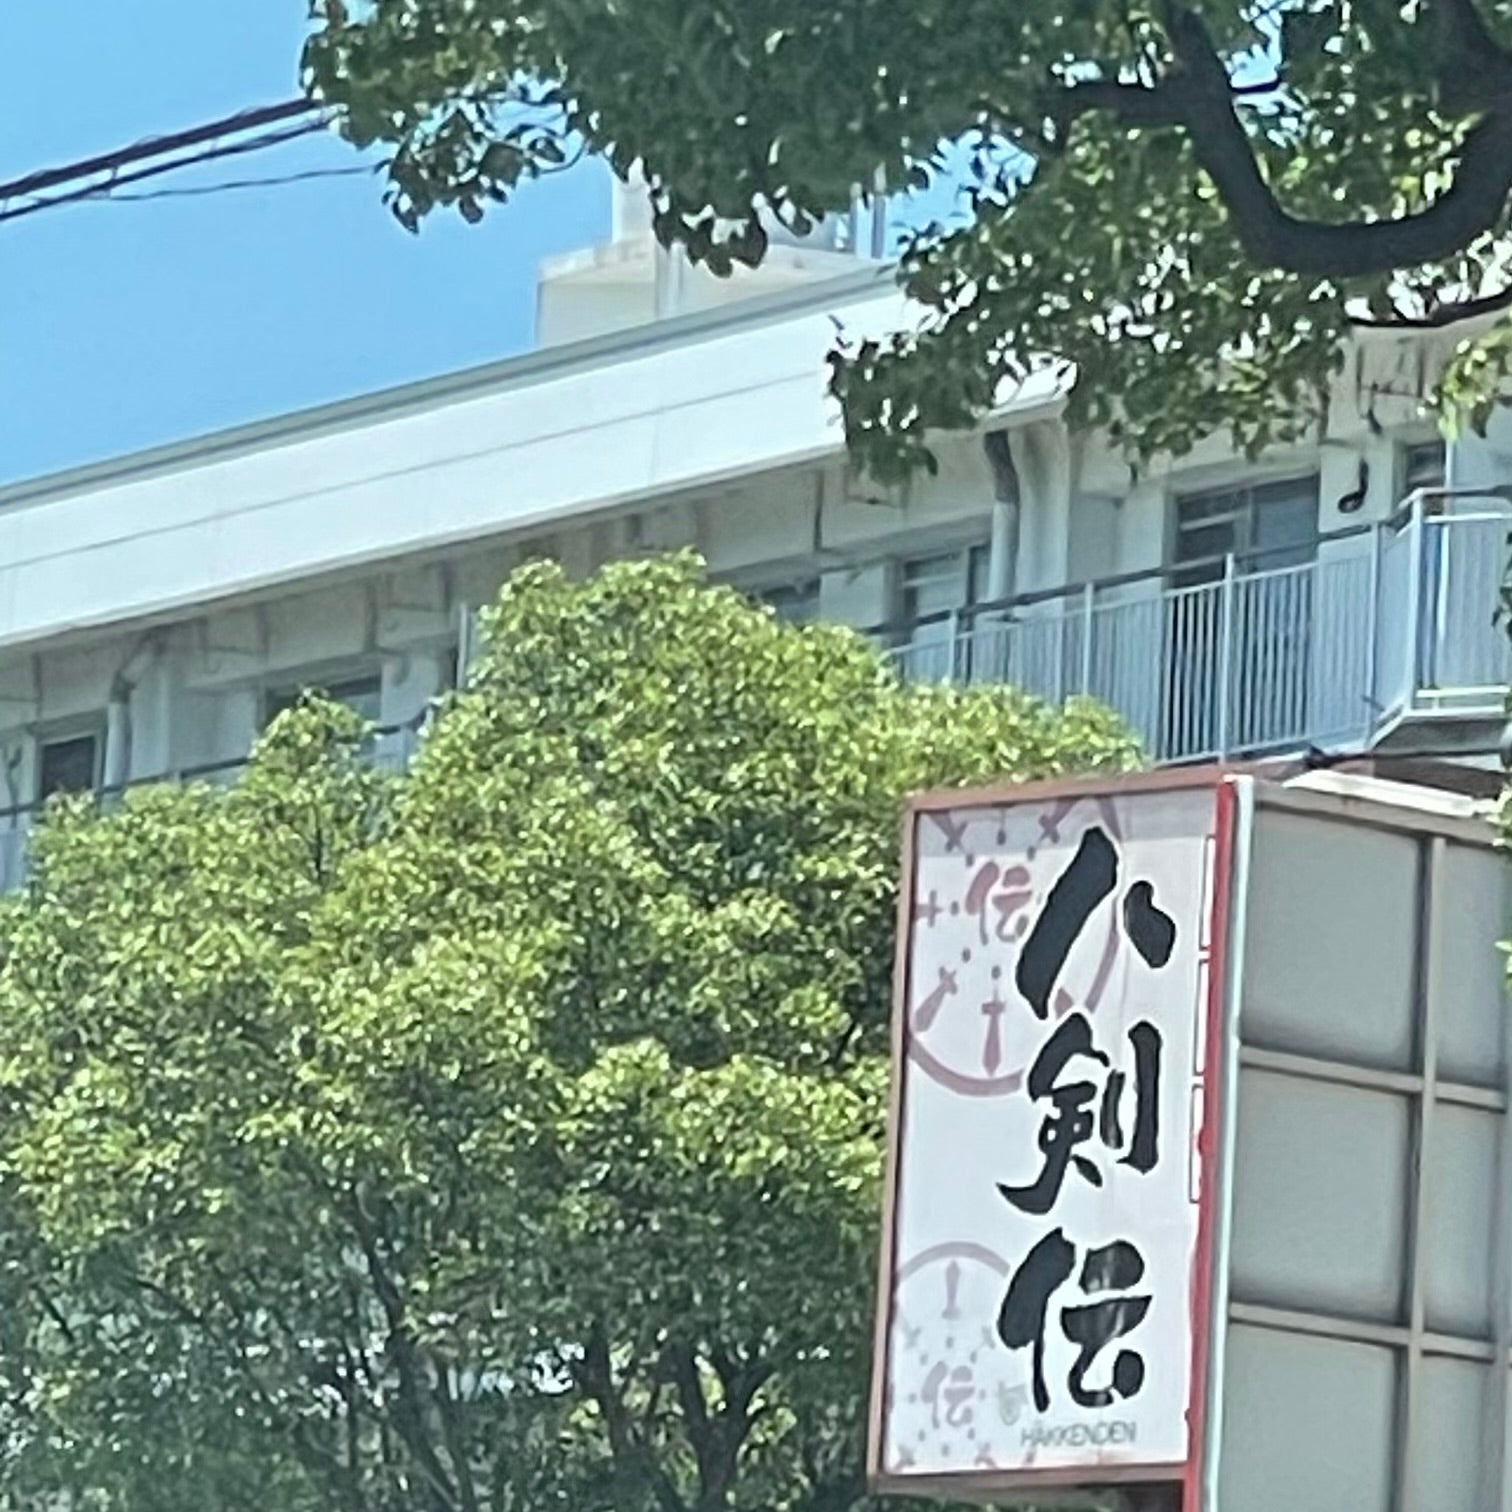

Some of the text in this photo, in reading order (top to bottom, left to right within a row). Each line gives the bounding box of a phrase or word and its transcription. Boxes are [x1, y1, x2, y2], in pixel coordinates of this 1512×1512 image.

[996, 825, 1177, 1412] 八剣伝
[1020, 1420, 1138, 1447] HAKKENDEN
